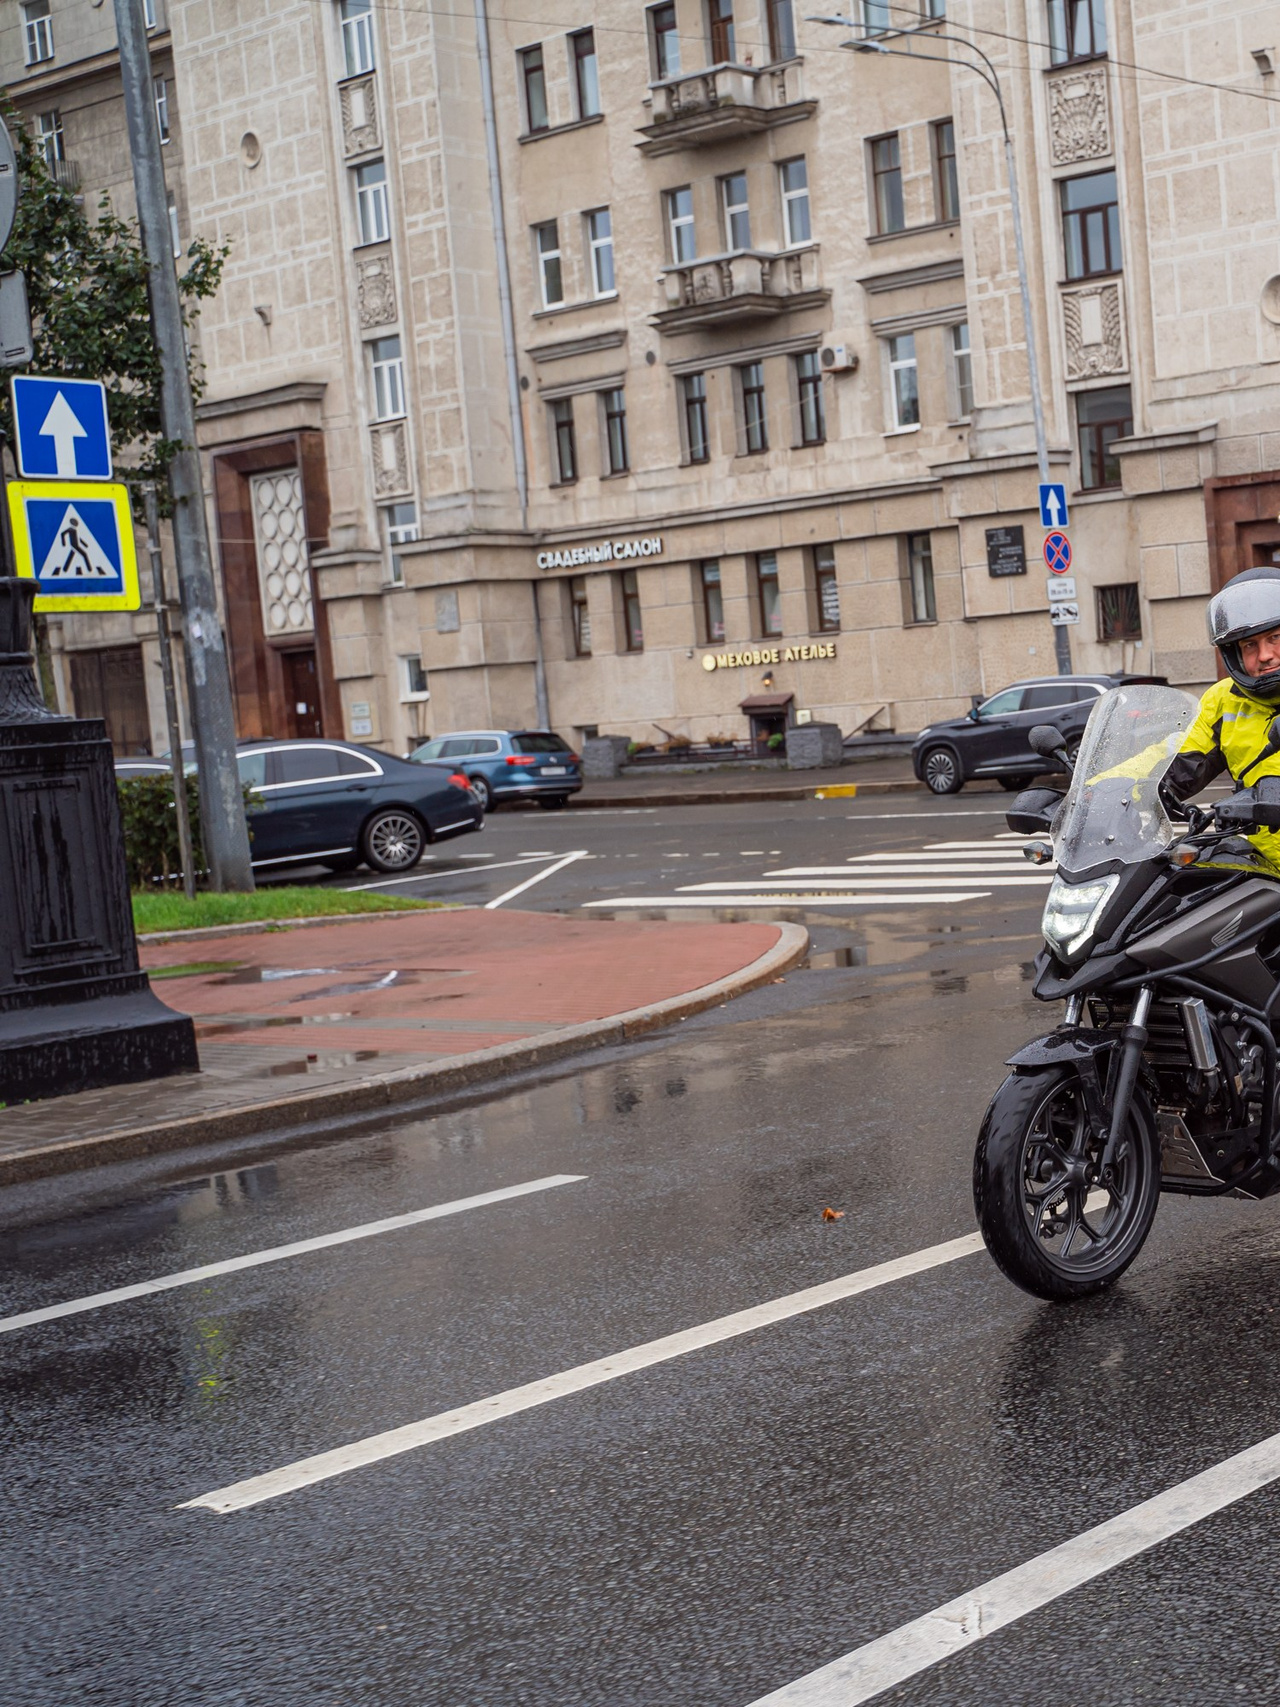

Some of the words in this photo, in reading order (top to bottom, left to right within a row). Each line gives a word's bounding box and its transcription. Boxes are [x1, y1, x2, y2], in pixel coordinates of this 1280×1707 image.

[537, 541, 613, 569] СВАДЕБНЫЙ
[613, 537, 662, 560] САЛОН
[716, 648, 780, 669] МЕХОВОЕ
[784, 642, 836, 662] АТЕЛЬЕ
